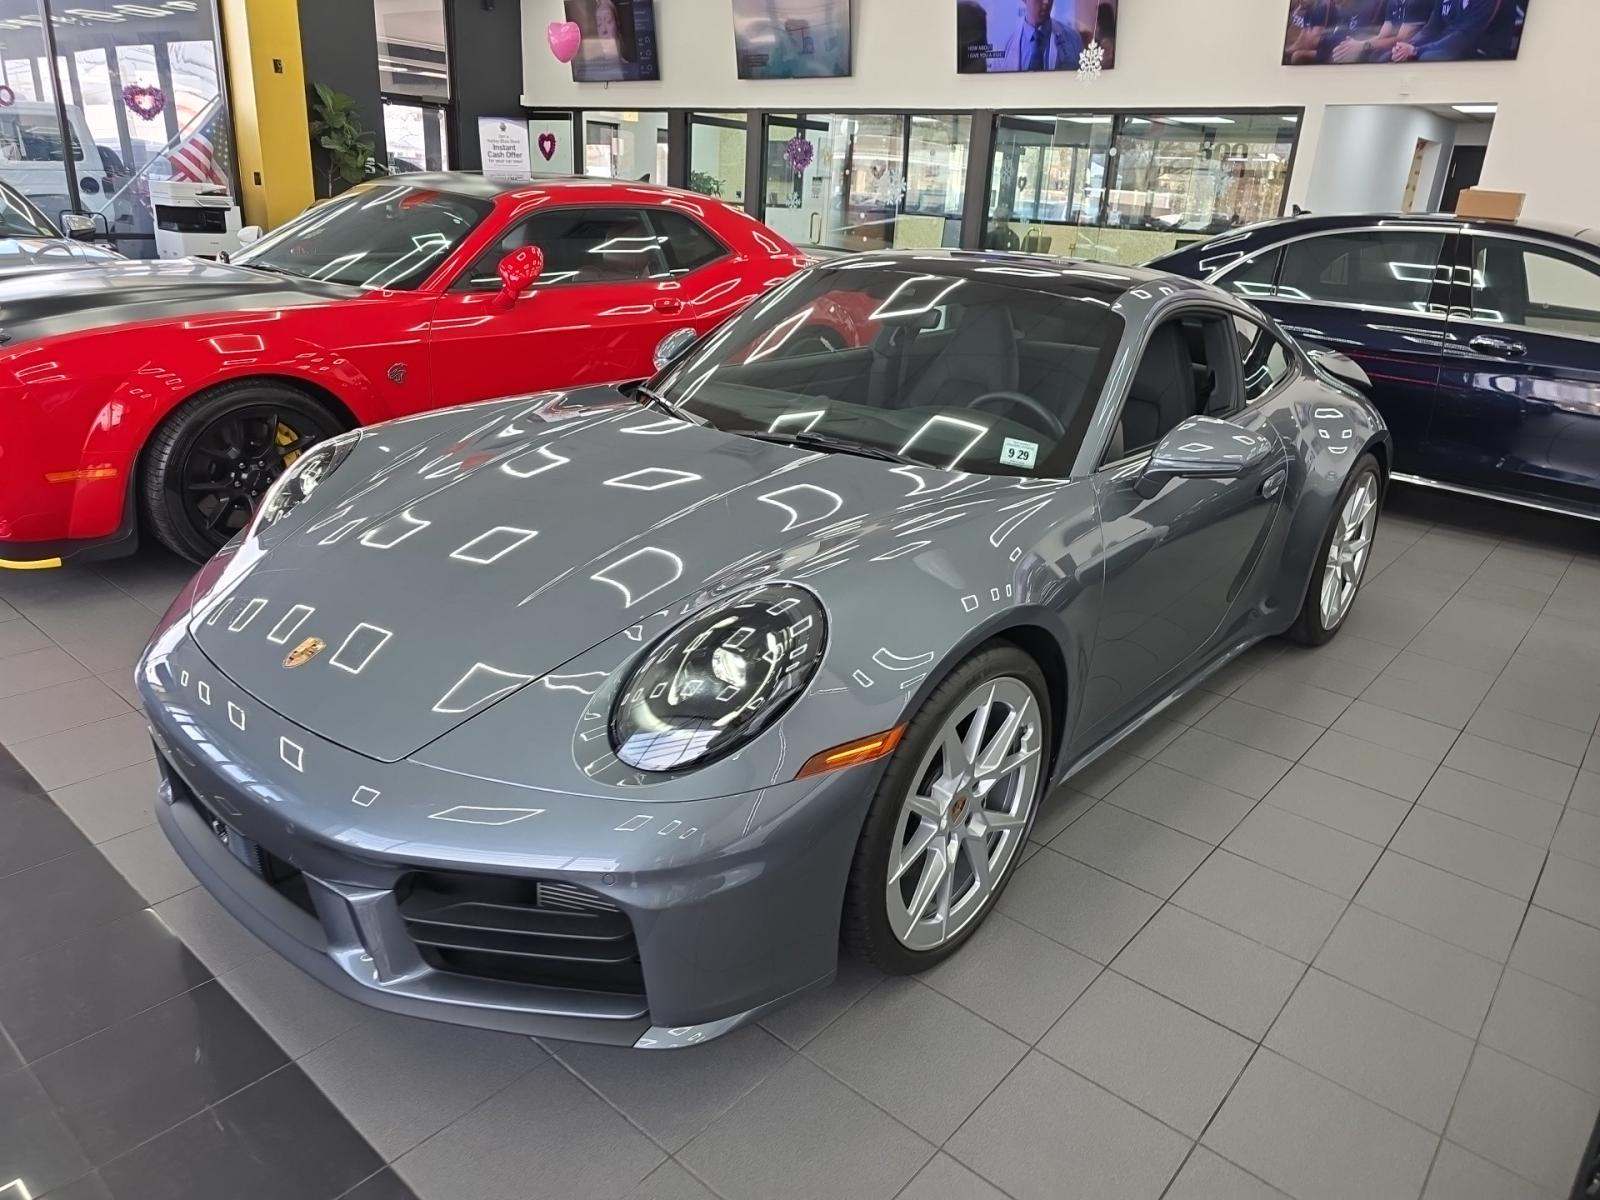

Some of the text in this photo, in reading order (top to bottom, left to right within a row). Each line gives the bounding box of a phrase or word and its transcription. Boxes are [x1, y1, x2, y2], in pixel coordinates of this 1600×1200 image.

[487, 150, 523, 159] Cash Offer
[1008, 448, 1029, 461] 9 29
